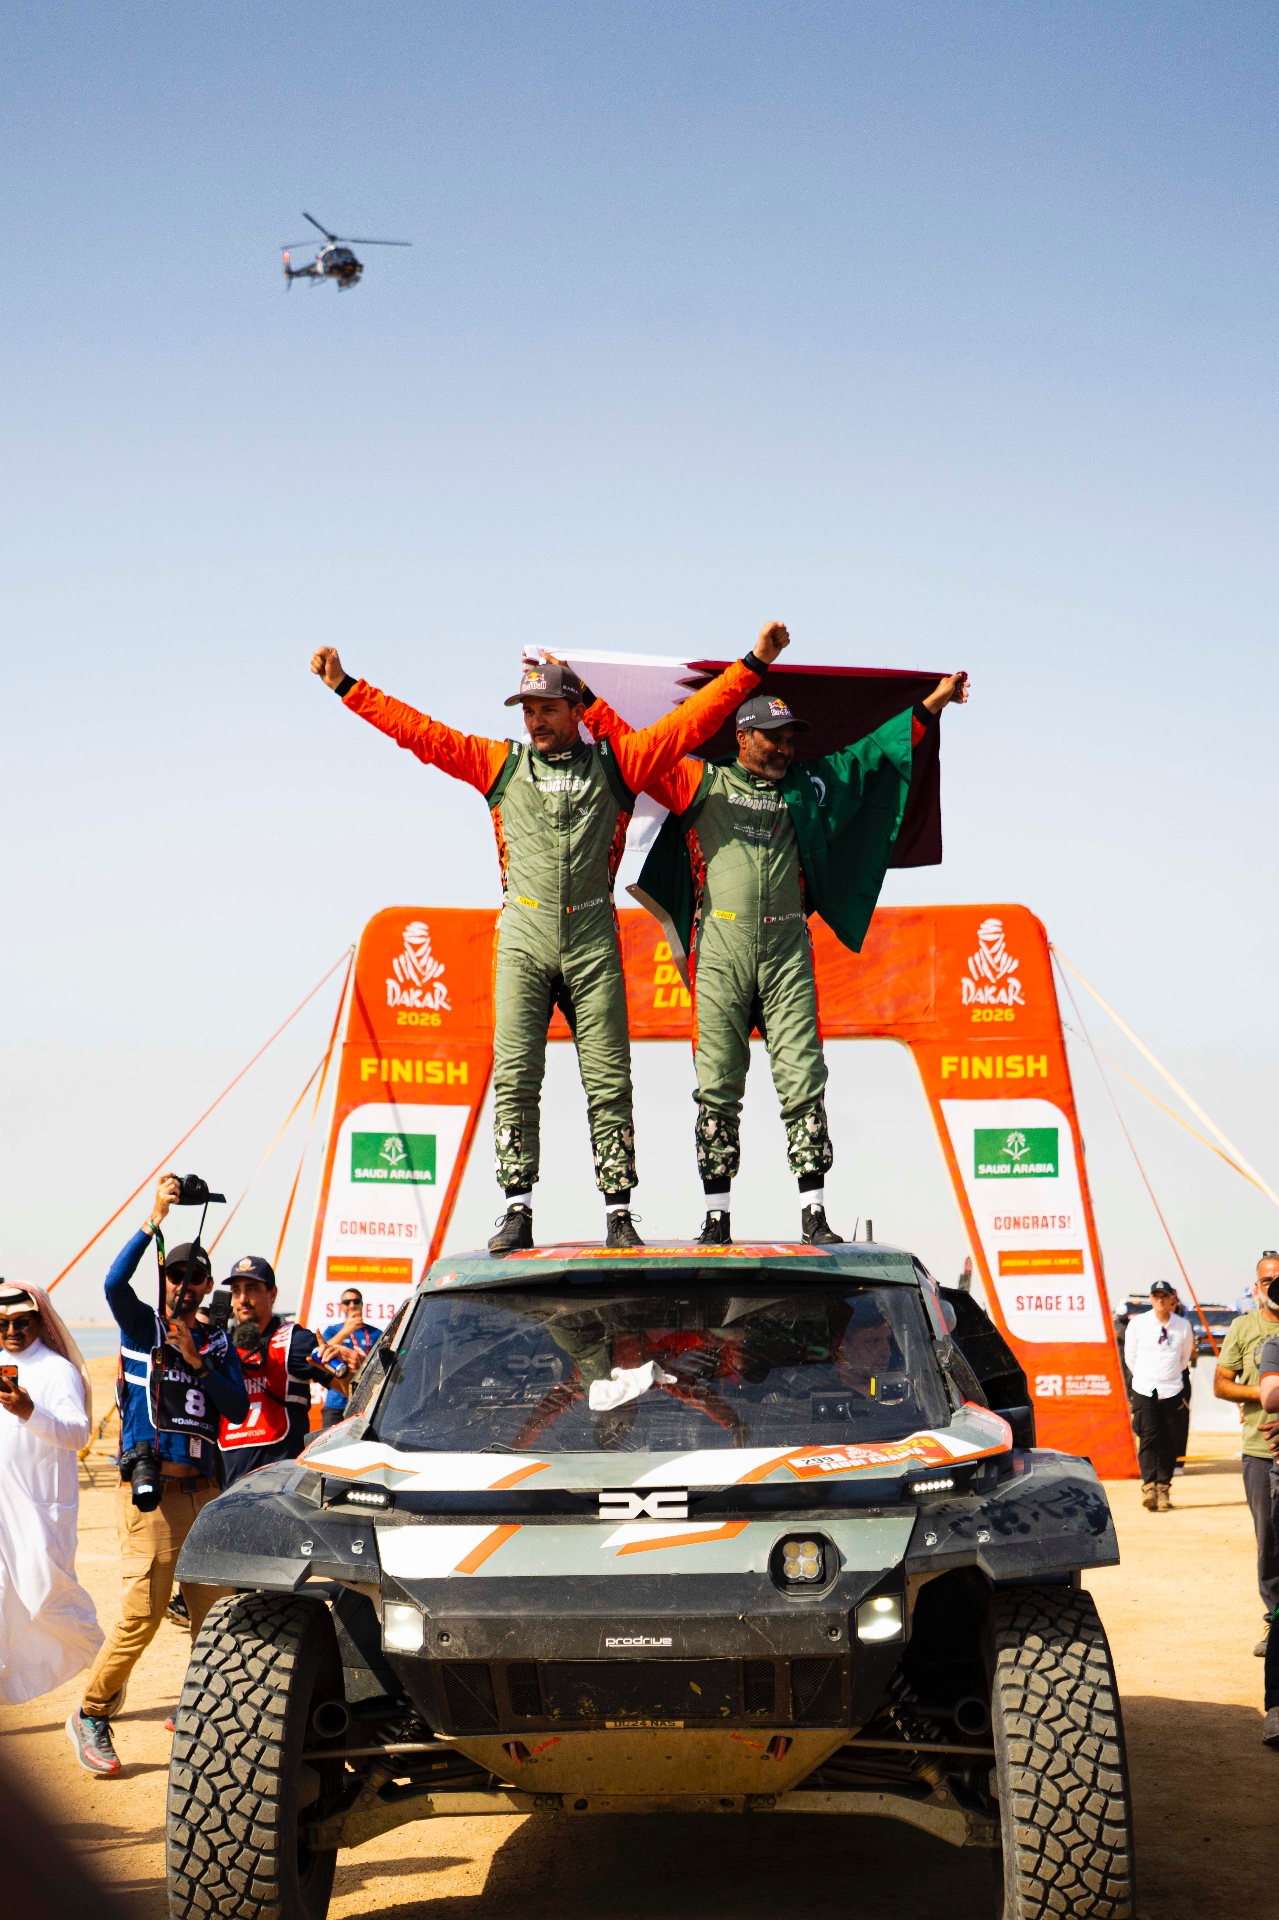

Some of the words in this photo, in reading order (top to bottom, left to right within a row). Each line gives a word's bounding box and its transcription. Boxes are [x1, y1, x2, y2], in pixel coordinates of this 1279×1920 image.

[386, 978, 452, 1011] DAKAR
[961, 977, 1025, 1006] DAKAR
[397, 1011, 442, 1026] 2026
[971, 1008, 1015, 1022] 2026
[361, 1058, 468, 1084] FINISH
[941, 1055, 1048, 1079] FINISH
[354, 1168, 388, 1179] SAUDI
[390, 1169, 432, 1180] ARABIA
[978, 1164, 1011, 1174] SAUDI
[1013, 1163, 1055, 1174] ARABIA
[340, 1221, 418, 1237] CONGRATS!
[994, 1215, 1071, 1231] CONGRATS!
[581, 1247, 640, 1255] DREAM.
[326, 1303, 374, 1318] STE
[378, 1304, 395, 1319] 13
[1016, 1296, 1062, 1311] STAGE
[1069, 1296, 1085, 1311] 13
[185, 1388, 206, 1418] 8
[880, 1438, 937, 1455] 2026
[801, 1455, 836, 1466] 299
[819, 1459, 868, 1471] SAUDI
[872, 1447, 927, 1465] ARABIA
[605, 1635, 673, 1648] prodrive
